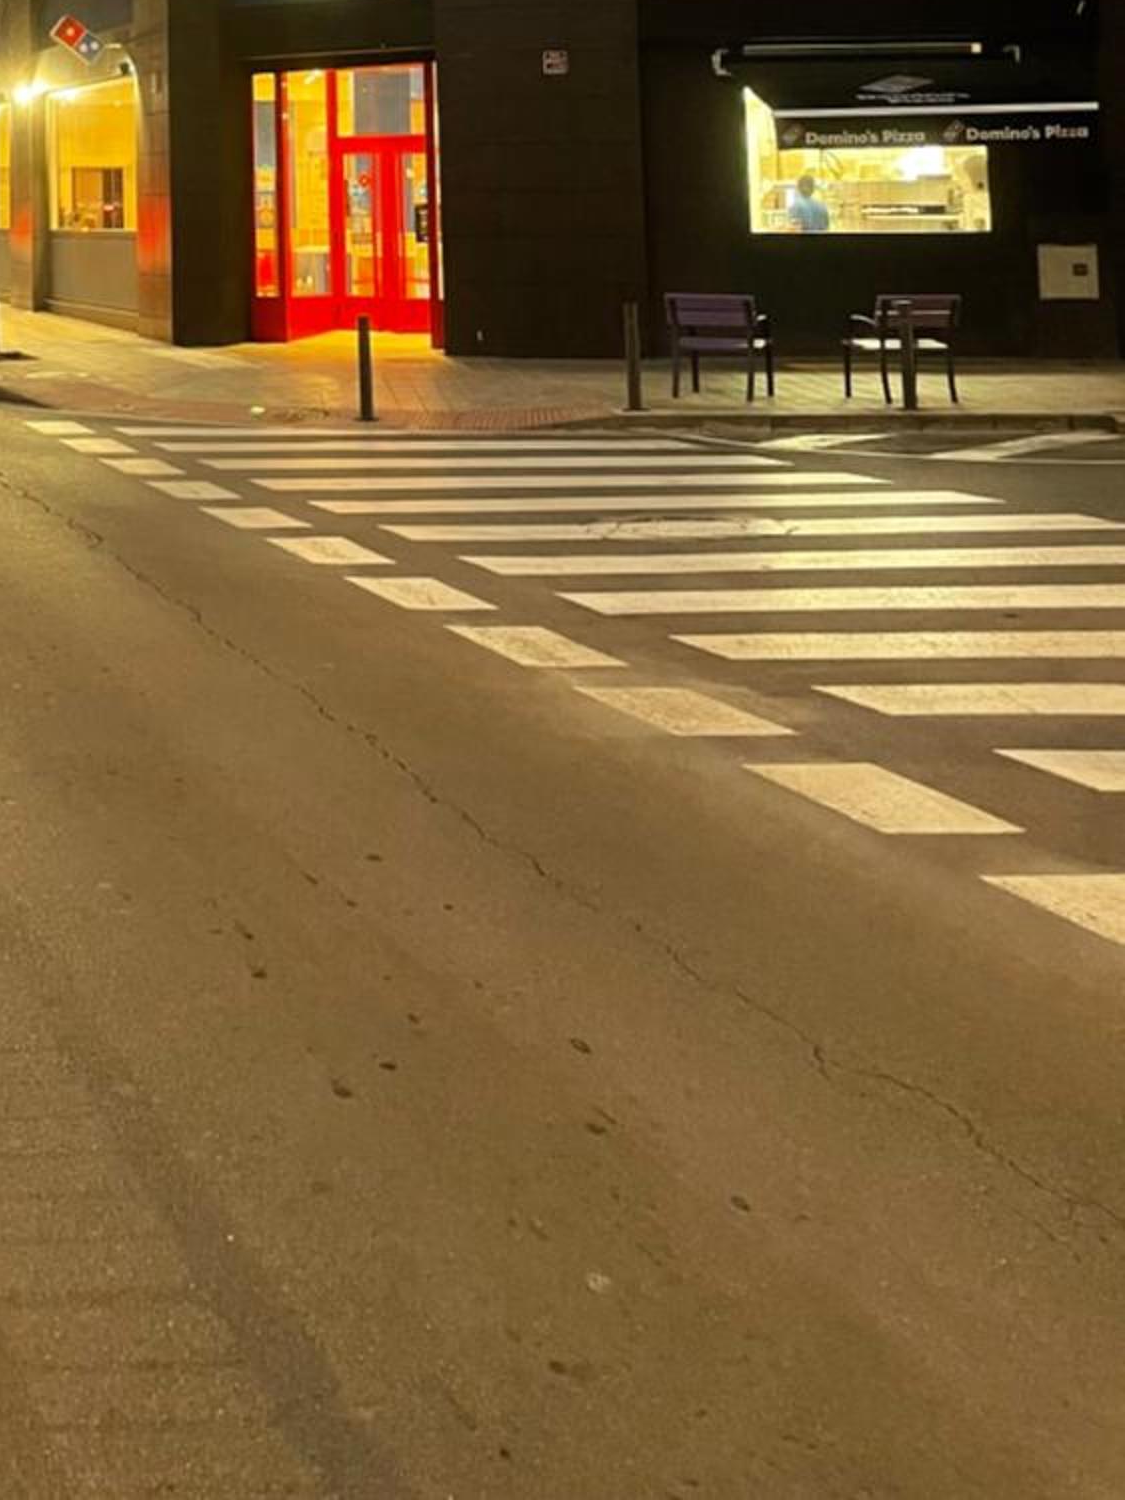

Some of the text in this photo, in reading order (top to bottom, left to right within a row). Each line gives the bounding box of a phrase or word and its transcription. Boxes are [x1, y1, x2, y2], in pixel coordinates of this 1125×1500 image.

[805, 128, 925, 145] Domino's Pizza
[966, 123, 1089, 141] Domino's Pizza
